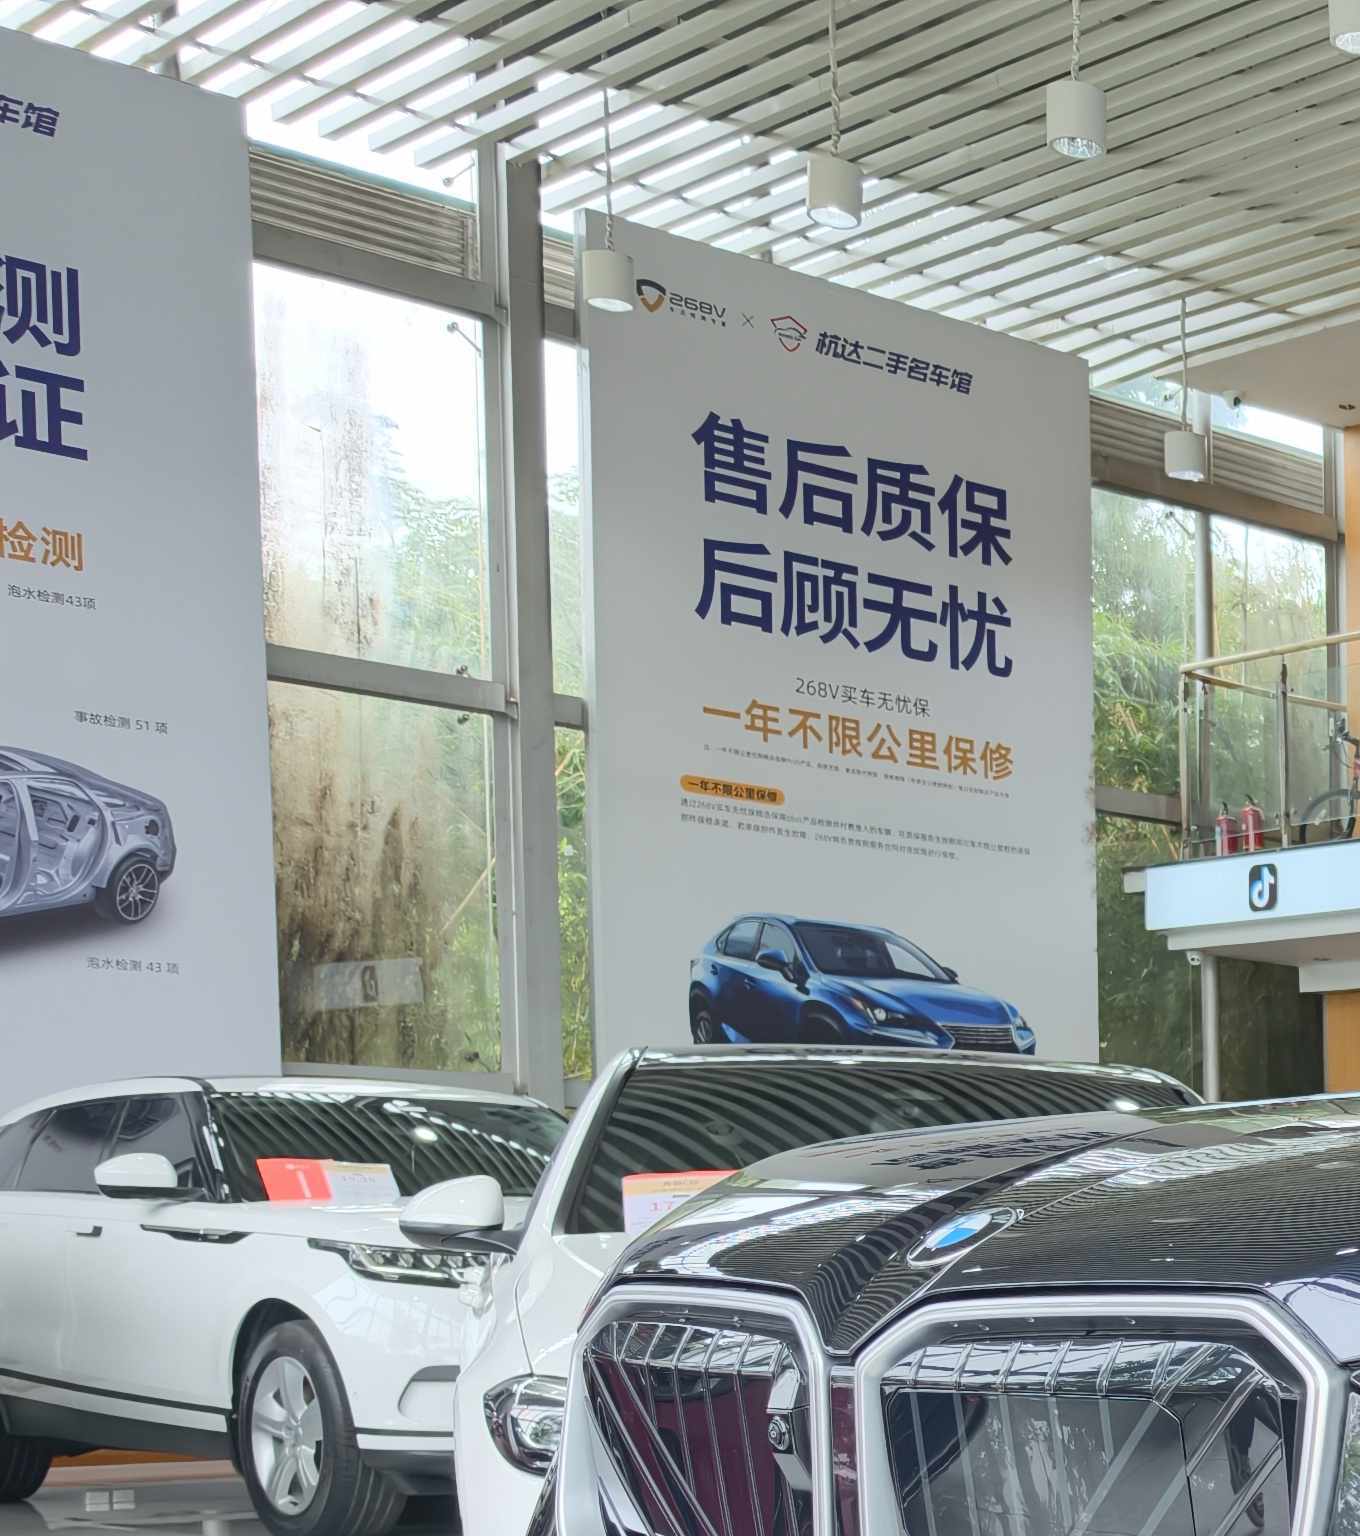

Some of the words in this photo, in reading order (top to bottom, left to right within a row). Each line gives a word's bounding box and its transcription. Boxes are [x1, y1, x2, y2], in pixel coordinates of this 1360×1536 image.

[669, 293, 726, 318] 268V
[815, 331, 973, 395] 杭达二手名车馆
[691, 411, 1013, 566] 售后质保
[695, 538, 1013, 678] 后顾无忧
[795, 677, 931, 718] 268V买车无忧保
[703, 699, 1014, 781] 一年不限公里保修
